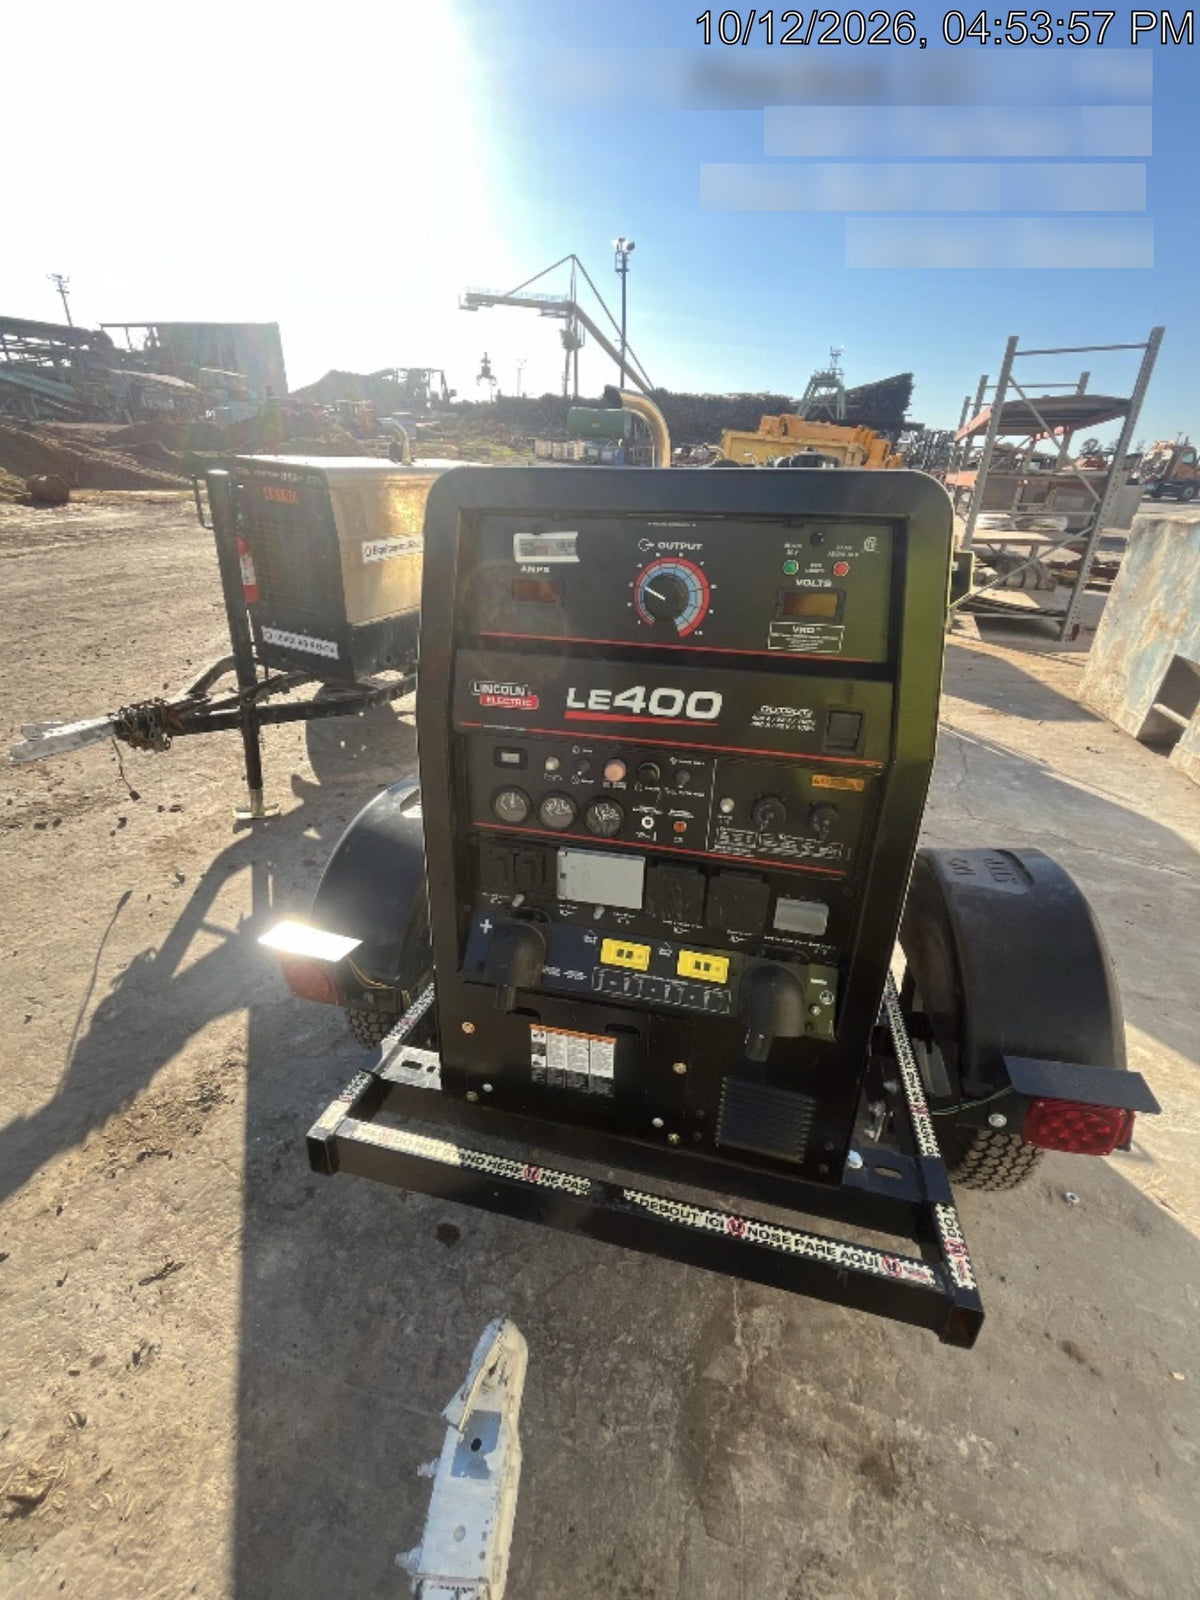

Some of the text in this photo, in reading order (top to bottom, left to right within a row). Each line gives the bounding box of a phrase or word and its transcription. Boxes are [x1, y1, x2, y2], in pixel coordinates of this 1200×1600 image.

[657, 541, 704, 551] OUTPUT
[520, 565, 551, 573] AMPS
[795, 578, 833, 588] VOLTS
[473, 682, 527, 697] LINCOLN
[485, 696, 533, 708] ELECTRIC
[565, 685, 723, 720] LE400
[793, 1239, 838, 1257] PARE
